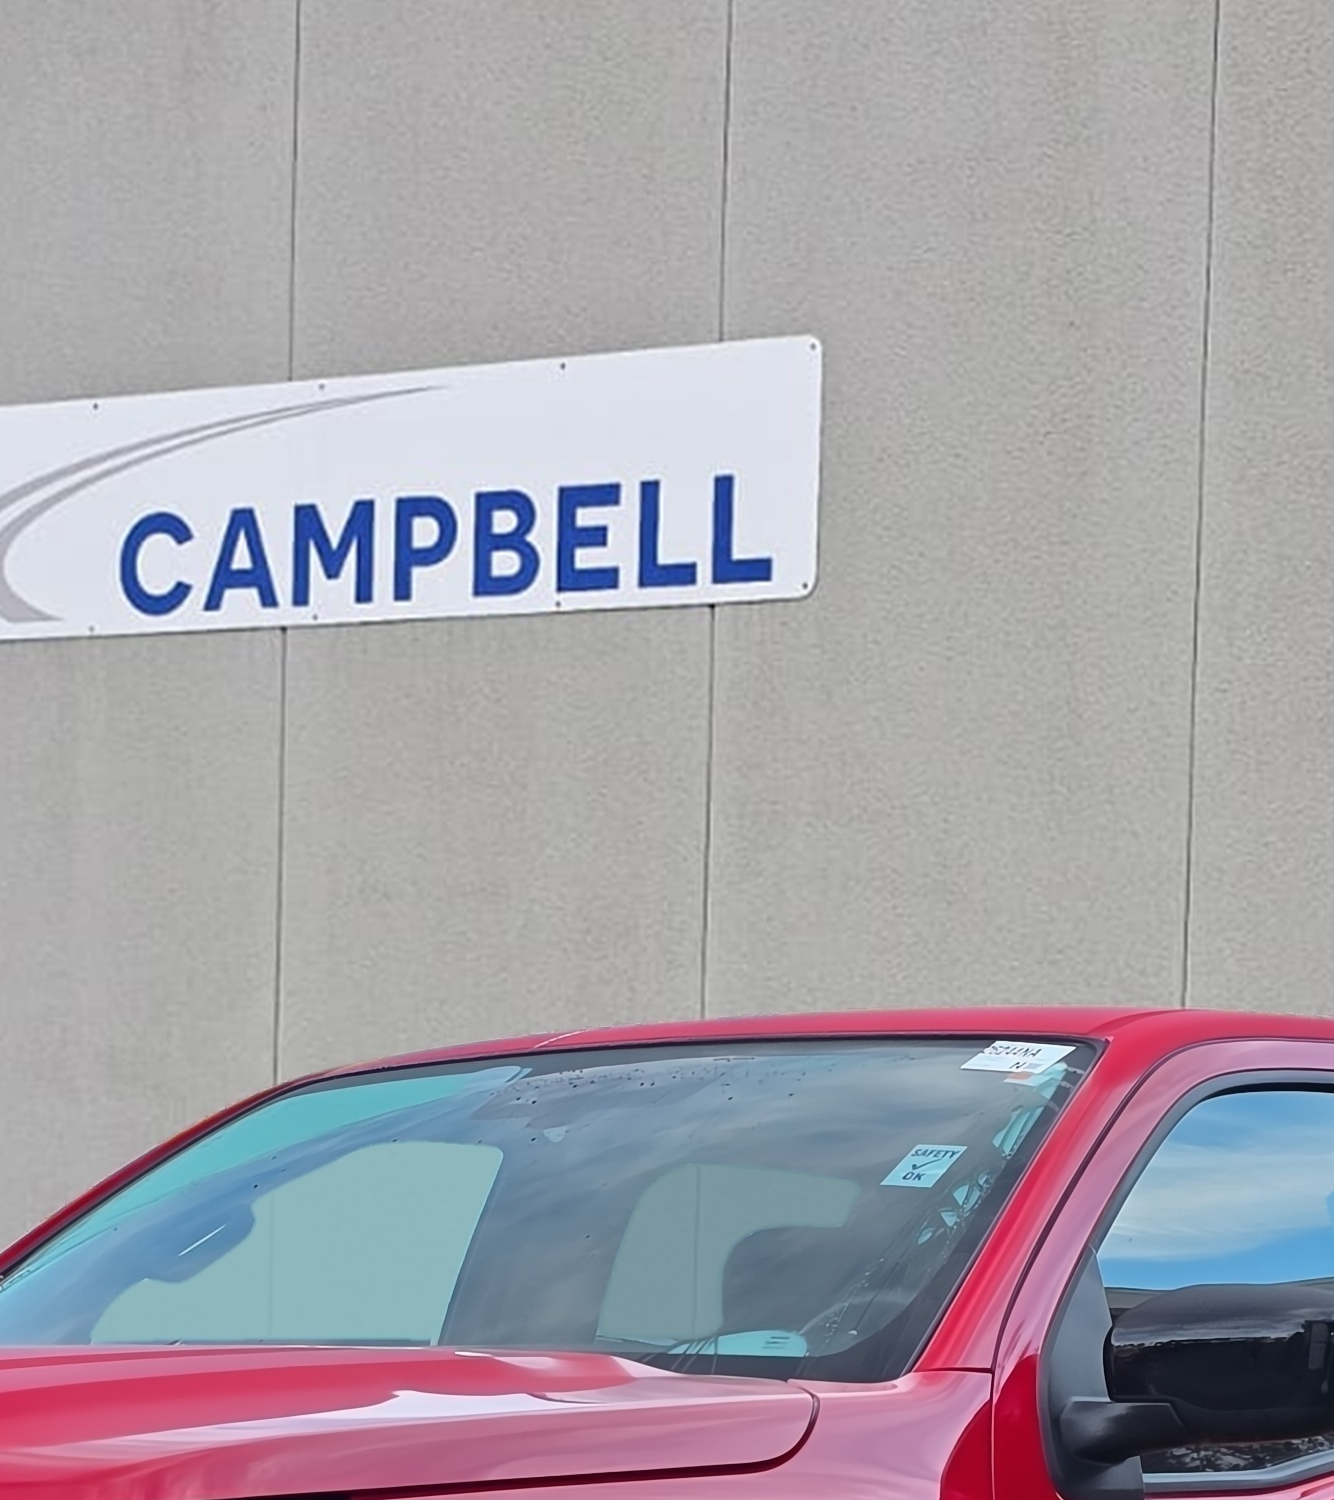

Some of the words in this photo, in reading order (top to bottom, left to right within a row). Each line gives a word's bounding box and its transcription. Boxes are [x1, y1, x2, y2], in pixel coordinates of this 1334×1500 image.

[121, 475, 773, 617] CAMPBELL
[910, 1148, 960, 1160] SAFETY
[902, 1171, 926, 1182] OK
